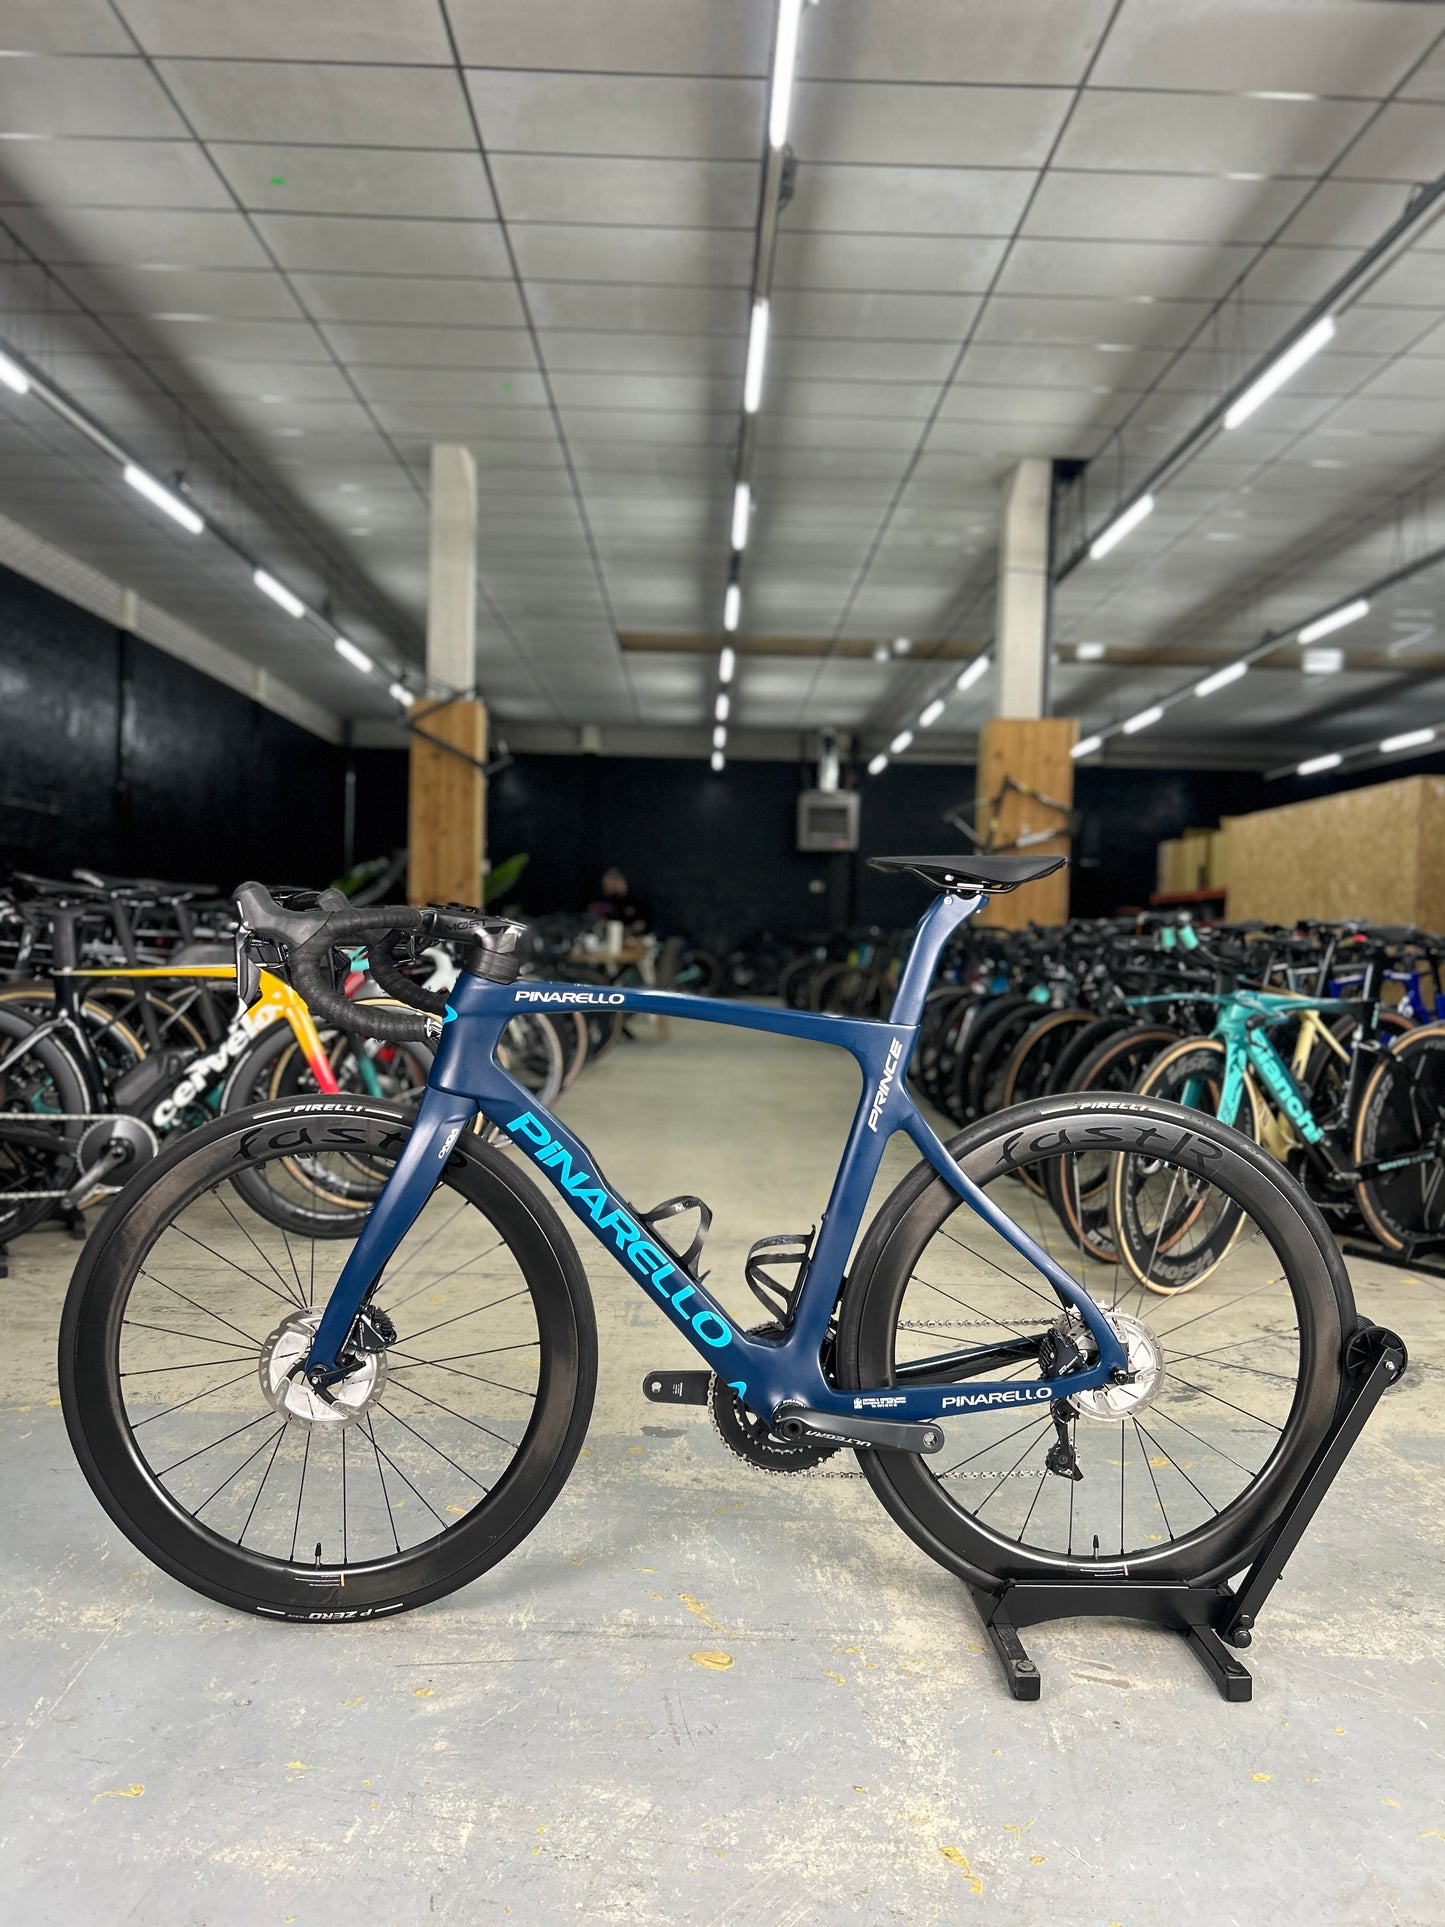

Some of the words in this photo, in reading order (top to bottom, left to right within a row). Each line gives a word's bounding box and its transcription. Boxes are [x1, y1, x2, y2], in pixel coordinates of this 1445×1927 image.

[515, 991, 625, 1004] PINARELLO
[868, 1037, 902, 1133] PRINCE
[293, 1103, 364, 1113] PIRELLI
[1080, 1102, 1148, 1112] PIRELLI
[506, 1111, 733, 1348] PINARELLO
[942, 1387, 1053, 1409] PINARELLO
[805, 1430, 872, 1447] ULTEGRA
[308, 1611, 358, 1620] ZERO
